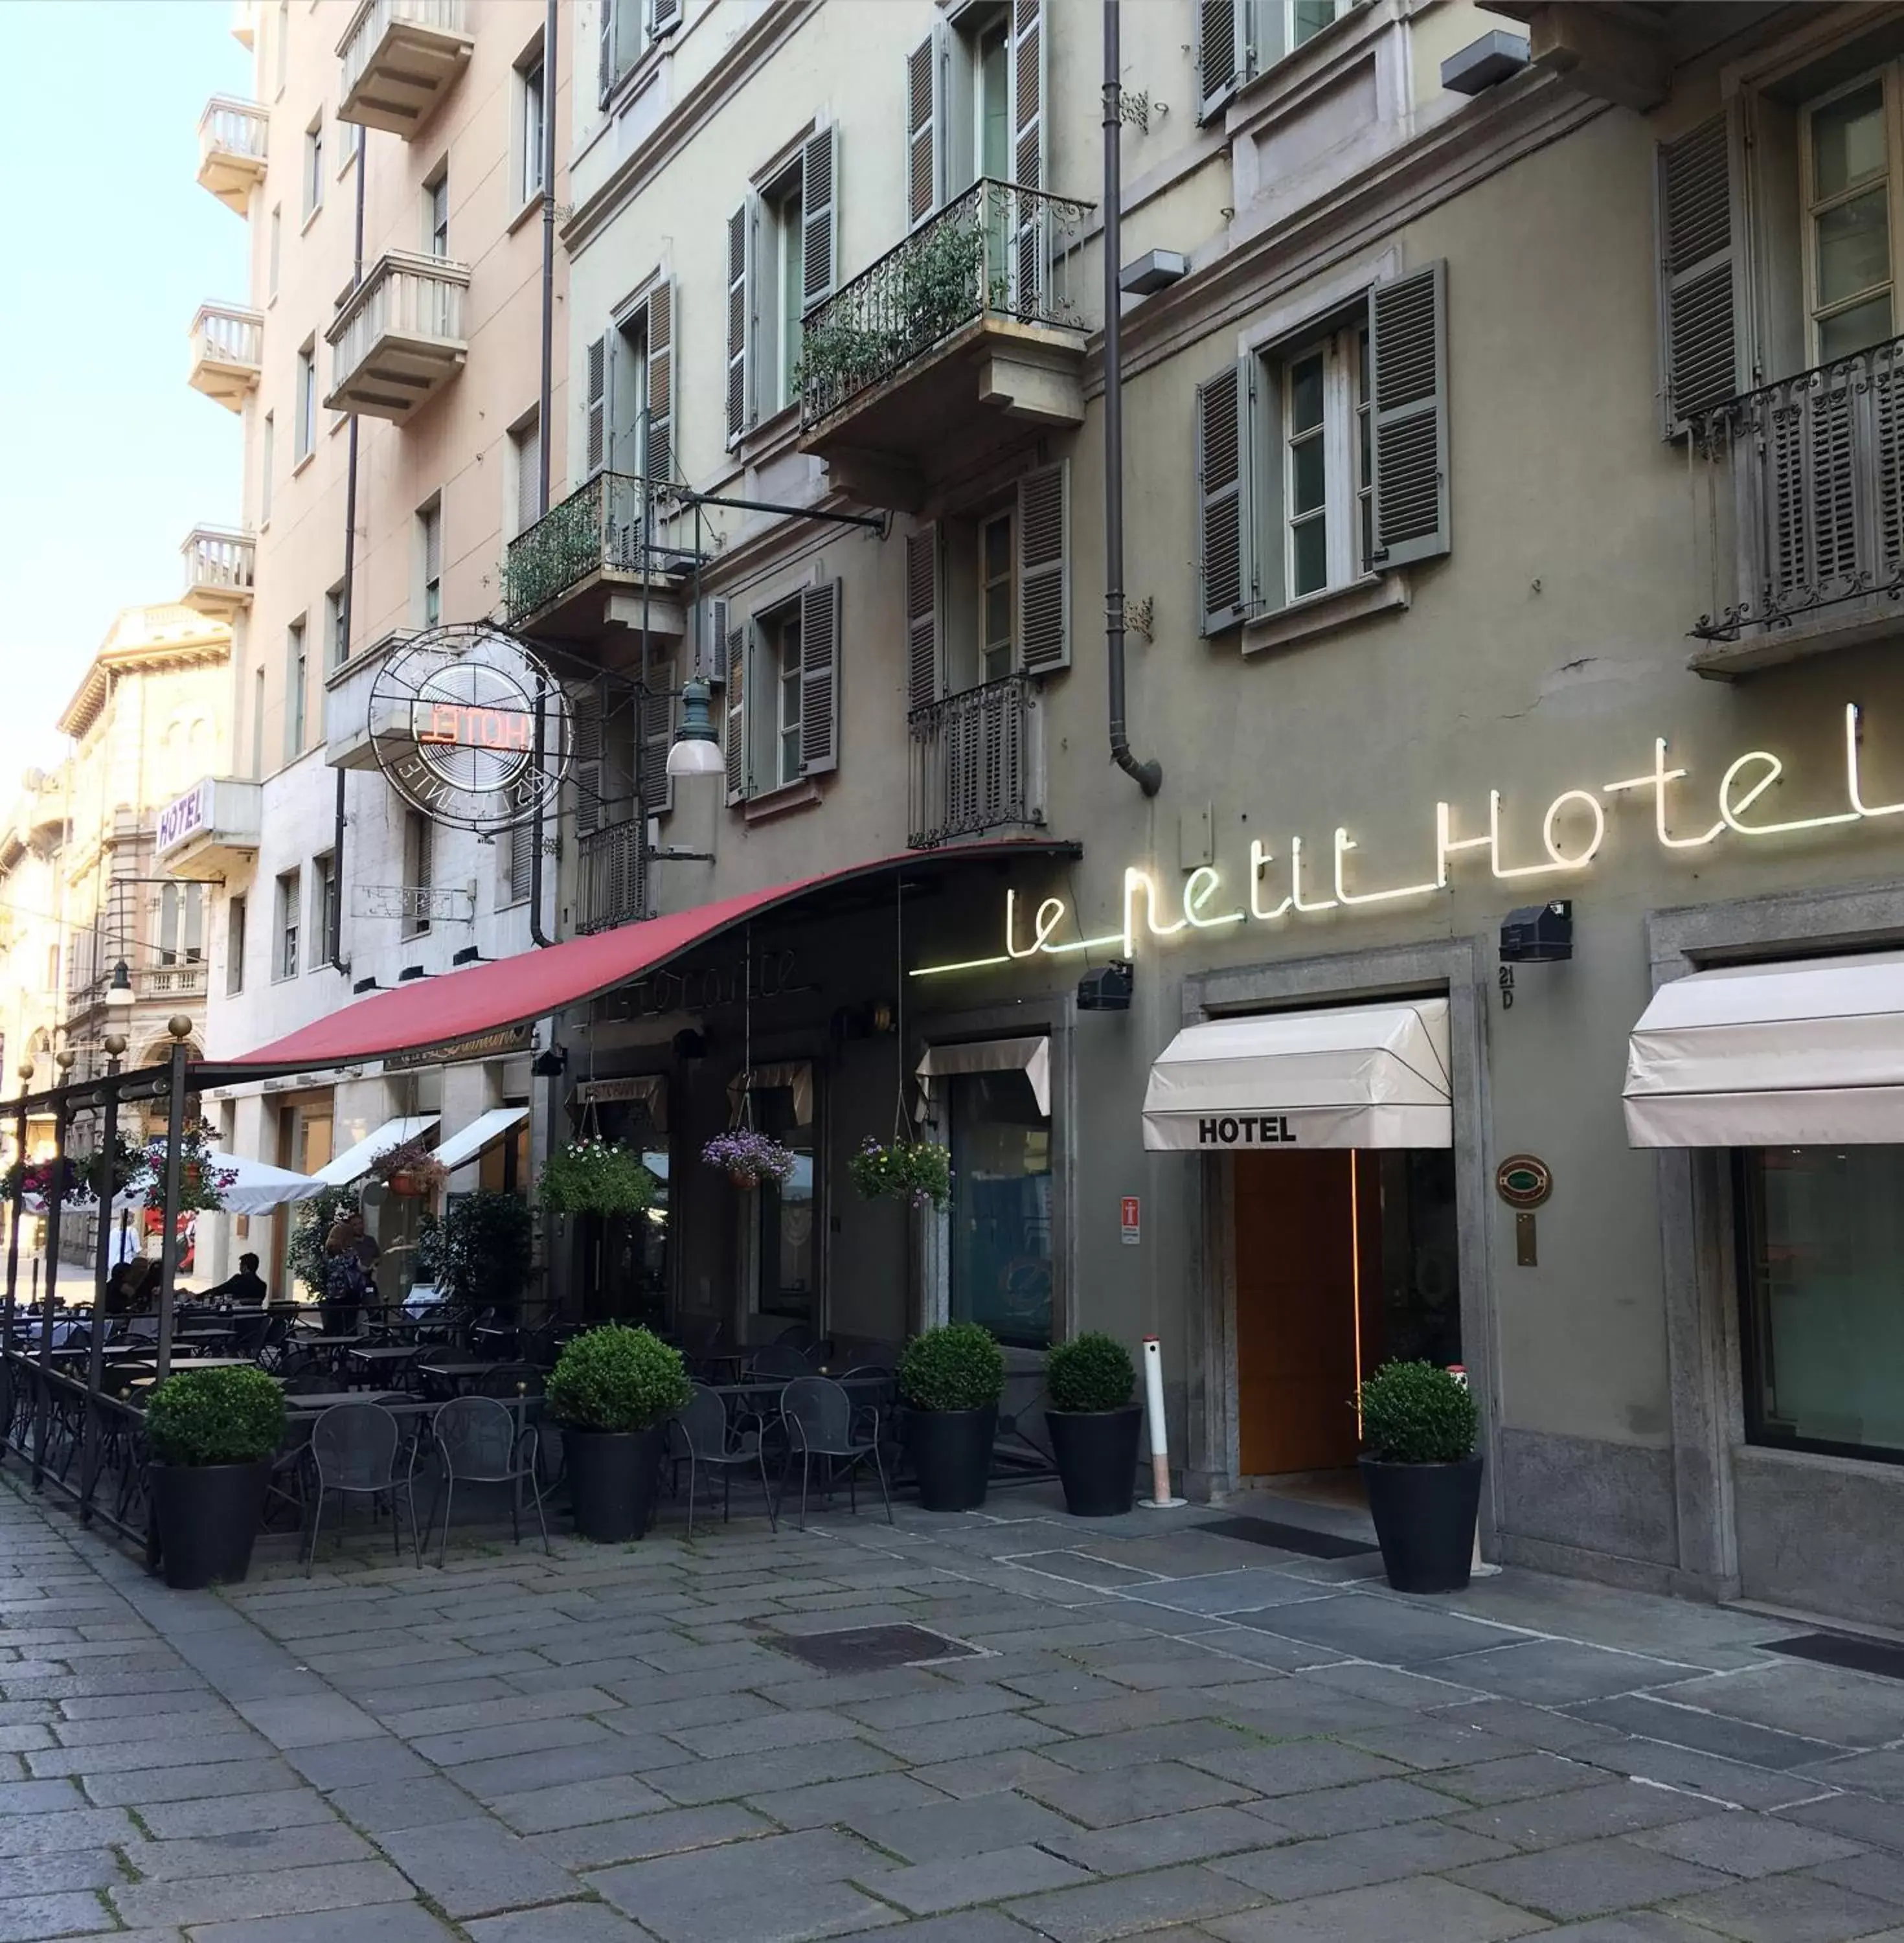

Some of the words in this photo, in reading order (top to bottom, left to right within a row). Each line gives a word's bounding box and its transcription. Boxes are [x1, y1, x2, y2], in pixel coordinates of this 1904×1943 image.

[159, 788, 201, 850] HOTEL
[1436, 703, 1904, 888] Hotel
[1199, 1115, 1297, 1143] HOTEL
